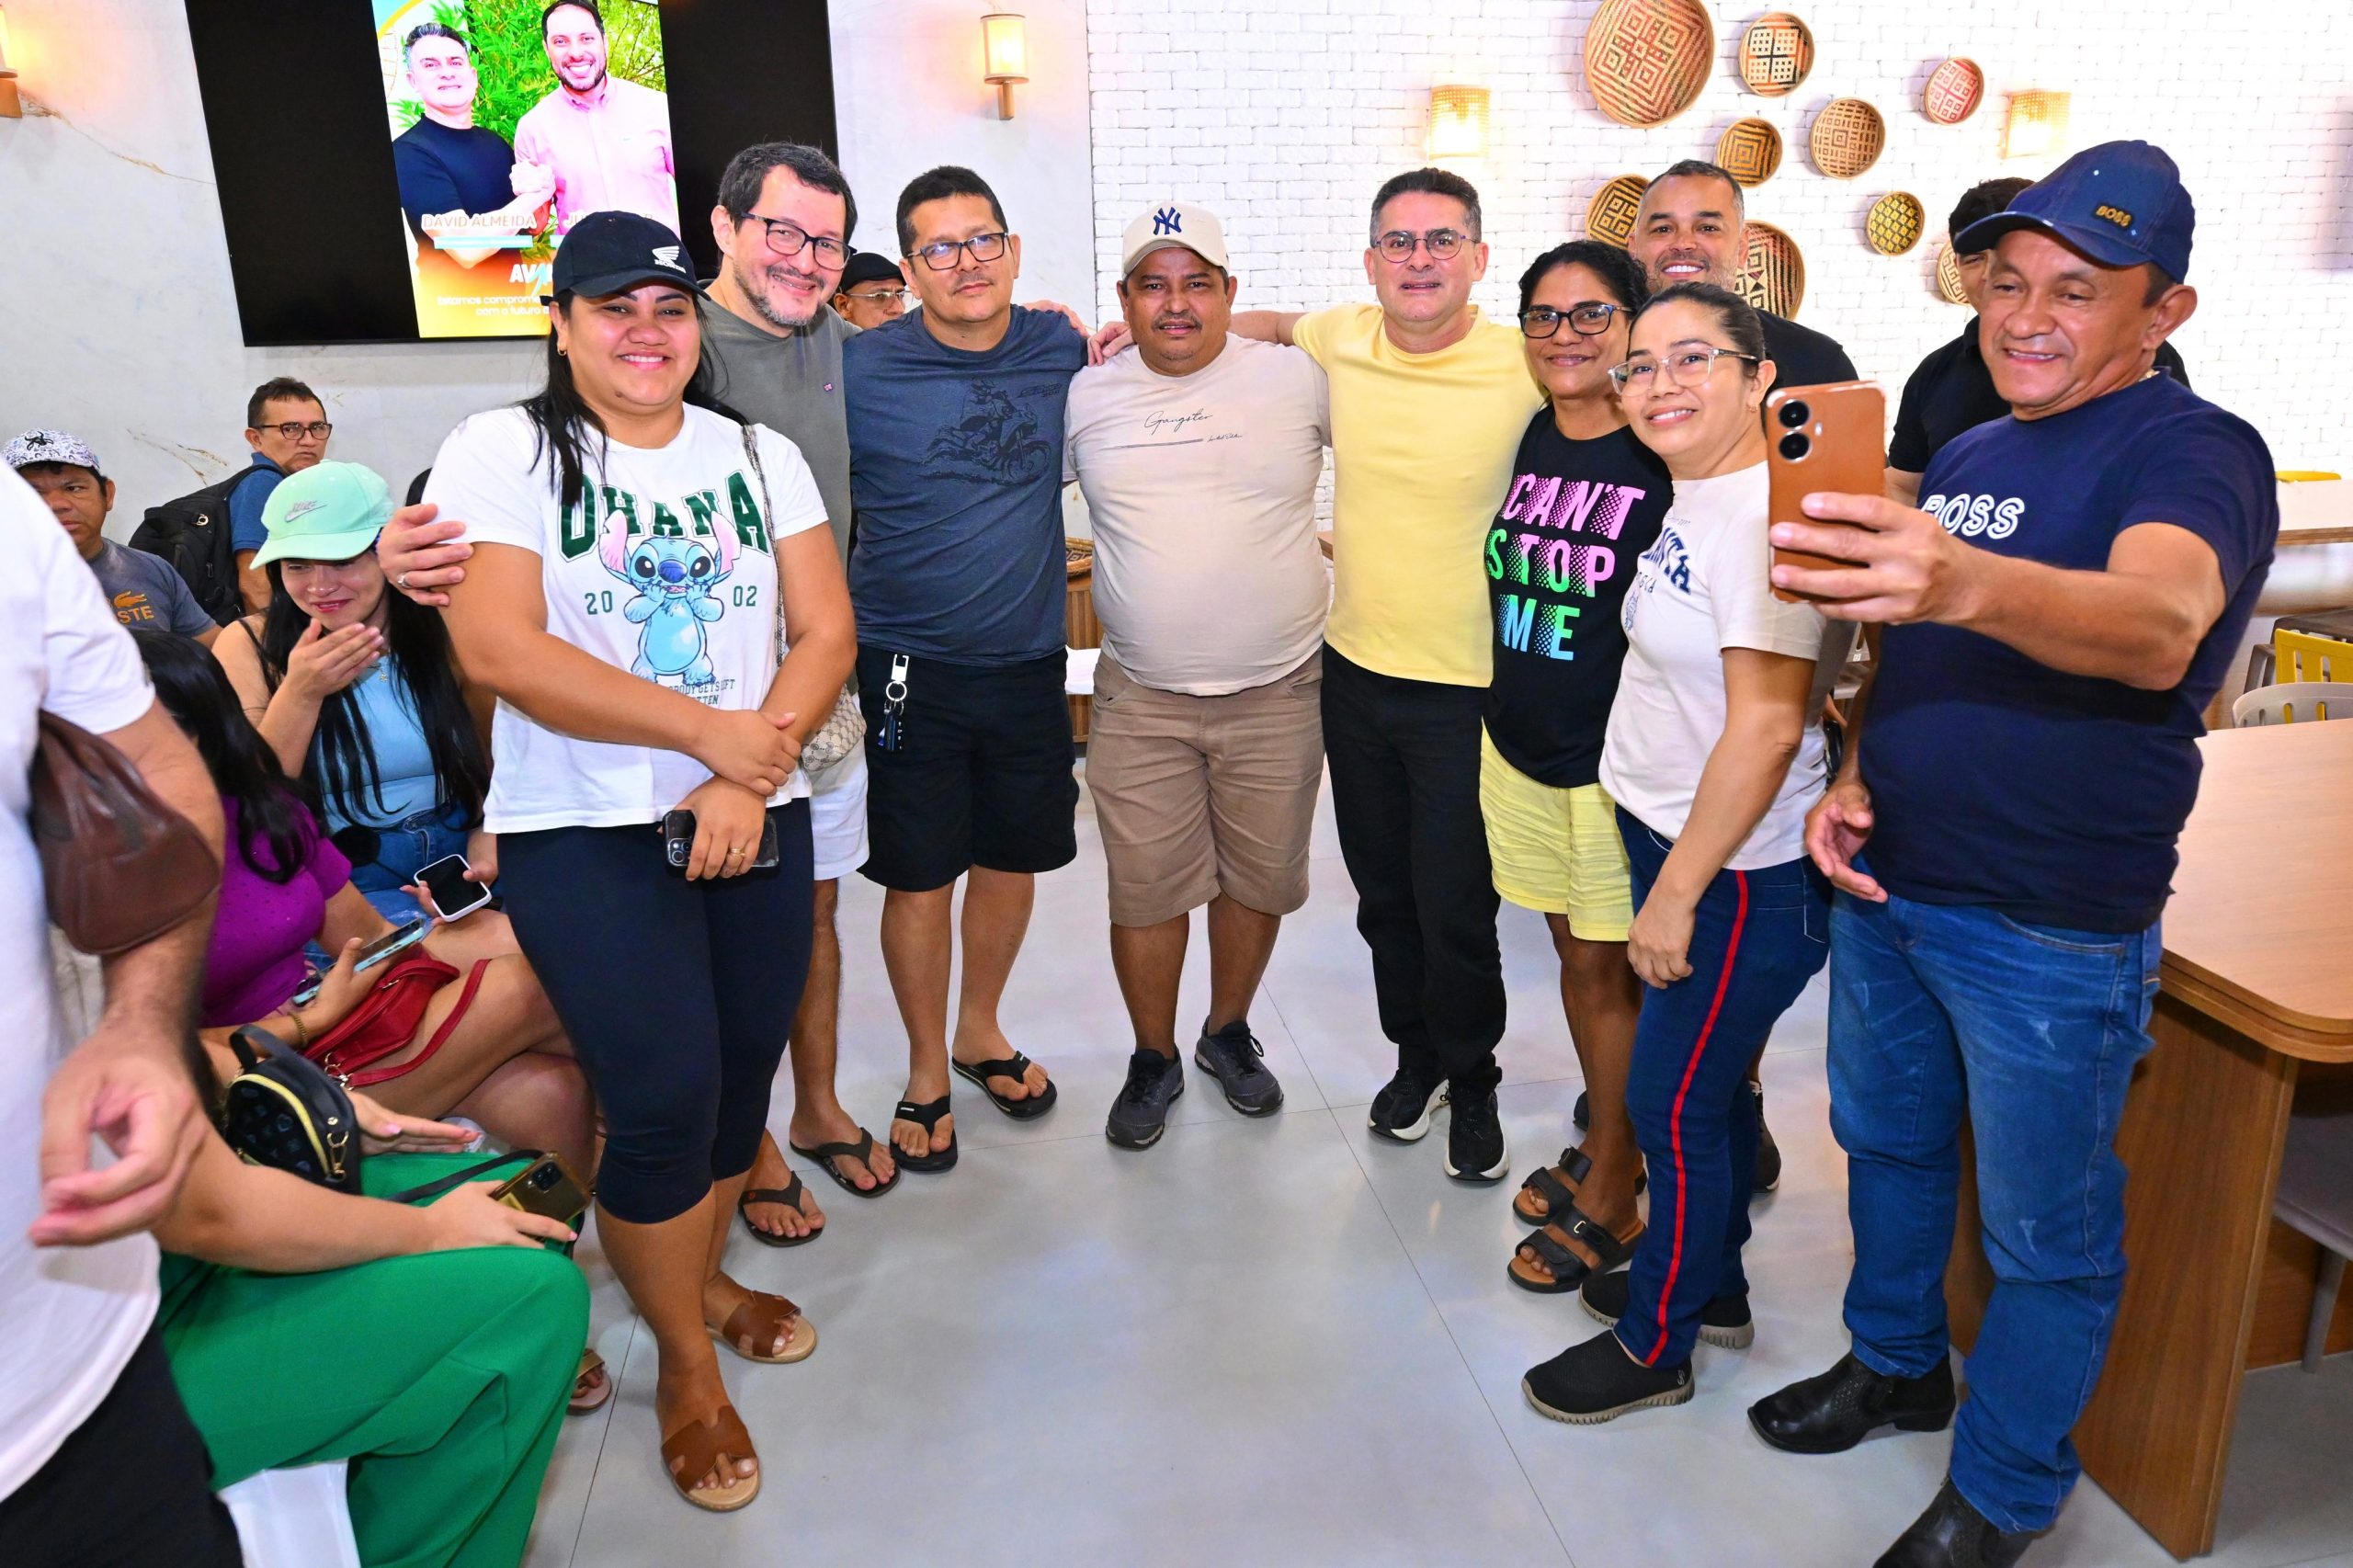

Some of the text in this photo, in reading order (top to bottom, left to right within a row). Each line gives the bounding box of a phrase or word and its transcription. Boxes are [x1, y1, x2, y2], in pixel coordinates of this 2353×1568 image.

[423, 214, 536, 228] DAVID ALMEIDA
[1153, 206, 1182, 235] NY
[2096, 205, 2132, 227] BOSS
[1144, 408, 1213, 435] Gangster
[559, 469, 771, 562] OHANA
[1484, 528, 1616, 597] STOP
[585, 590, 613, 615] 20
[733, 585, 757, 607] 02
[117, 605, 154, 624] STE
[1498, 594, 1580, 661] ME
